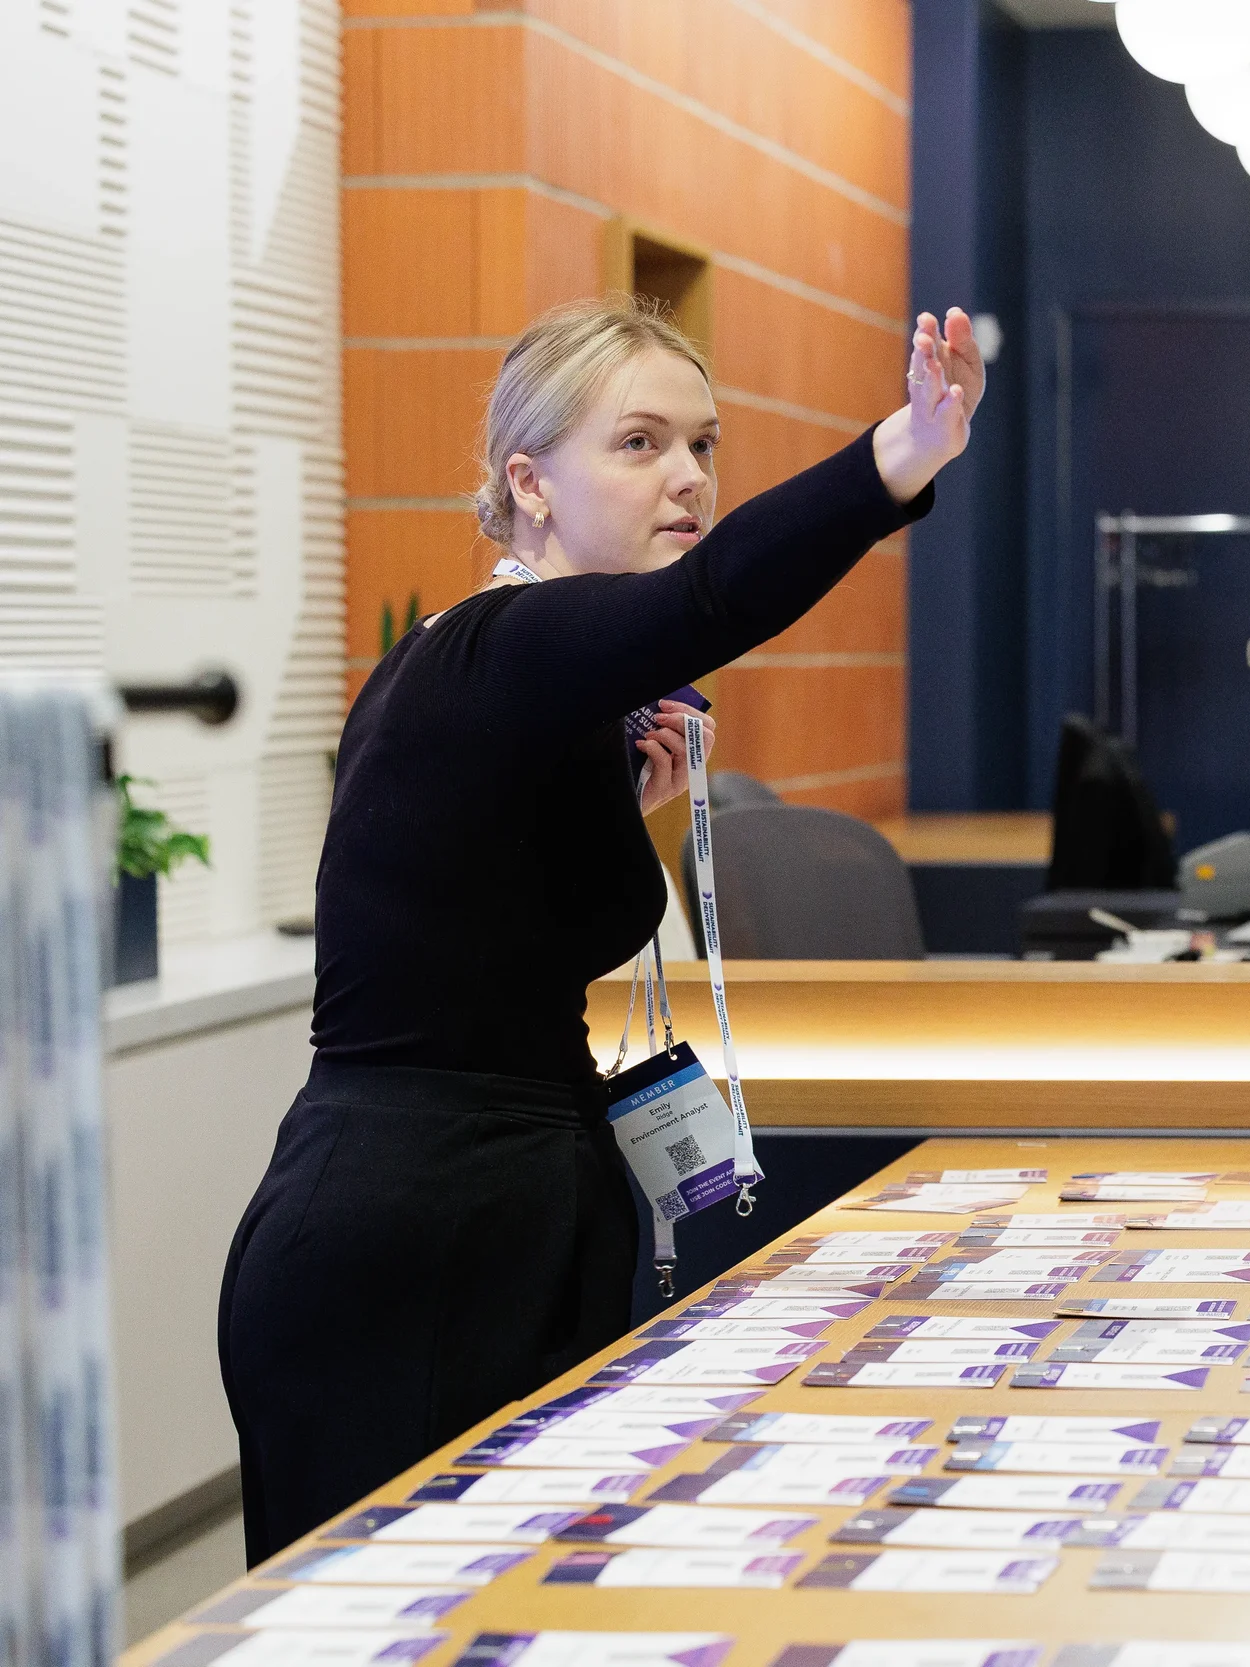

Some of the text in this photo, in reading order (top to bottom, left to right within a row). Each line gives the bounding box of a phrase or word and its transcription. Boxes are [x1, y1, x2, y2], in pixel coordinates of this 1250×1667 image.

[687, 719, 695, 746] DELIVERY
[701, 809, 710, 856] SUSTAINABILITY
[703, 902, 711, 930] DELIVERY
[709, 902, 718, 949] SUSTAINABILITY
[631, 1079, 676, 1106] MEMBER
[731, 1083, 739, 1111] DELIVERY
[735, 1084, 748, 1129] SUSTAINABILITY
[649, 1102, 671, 1116] Emily
[630, 1103, 709, 1145] Environment Analyst
[686, 1187, 699, 1196] JOIN
[698, 1181, 709, 1190] THE
[709, 1174, 726, 1184] EVENT
[689, 1194, 702, 1203] USE
[701, 1187, 715, 1198] JOIN
[715, 1179, 733, 1191] CODE:
